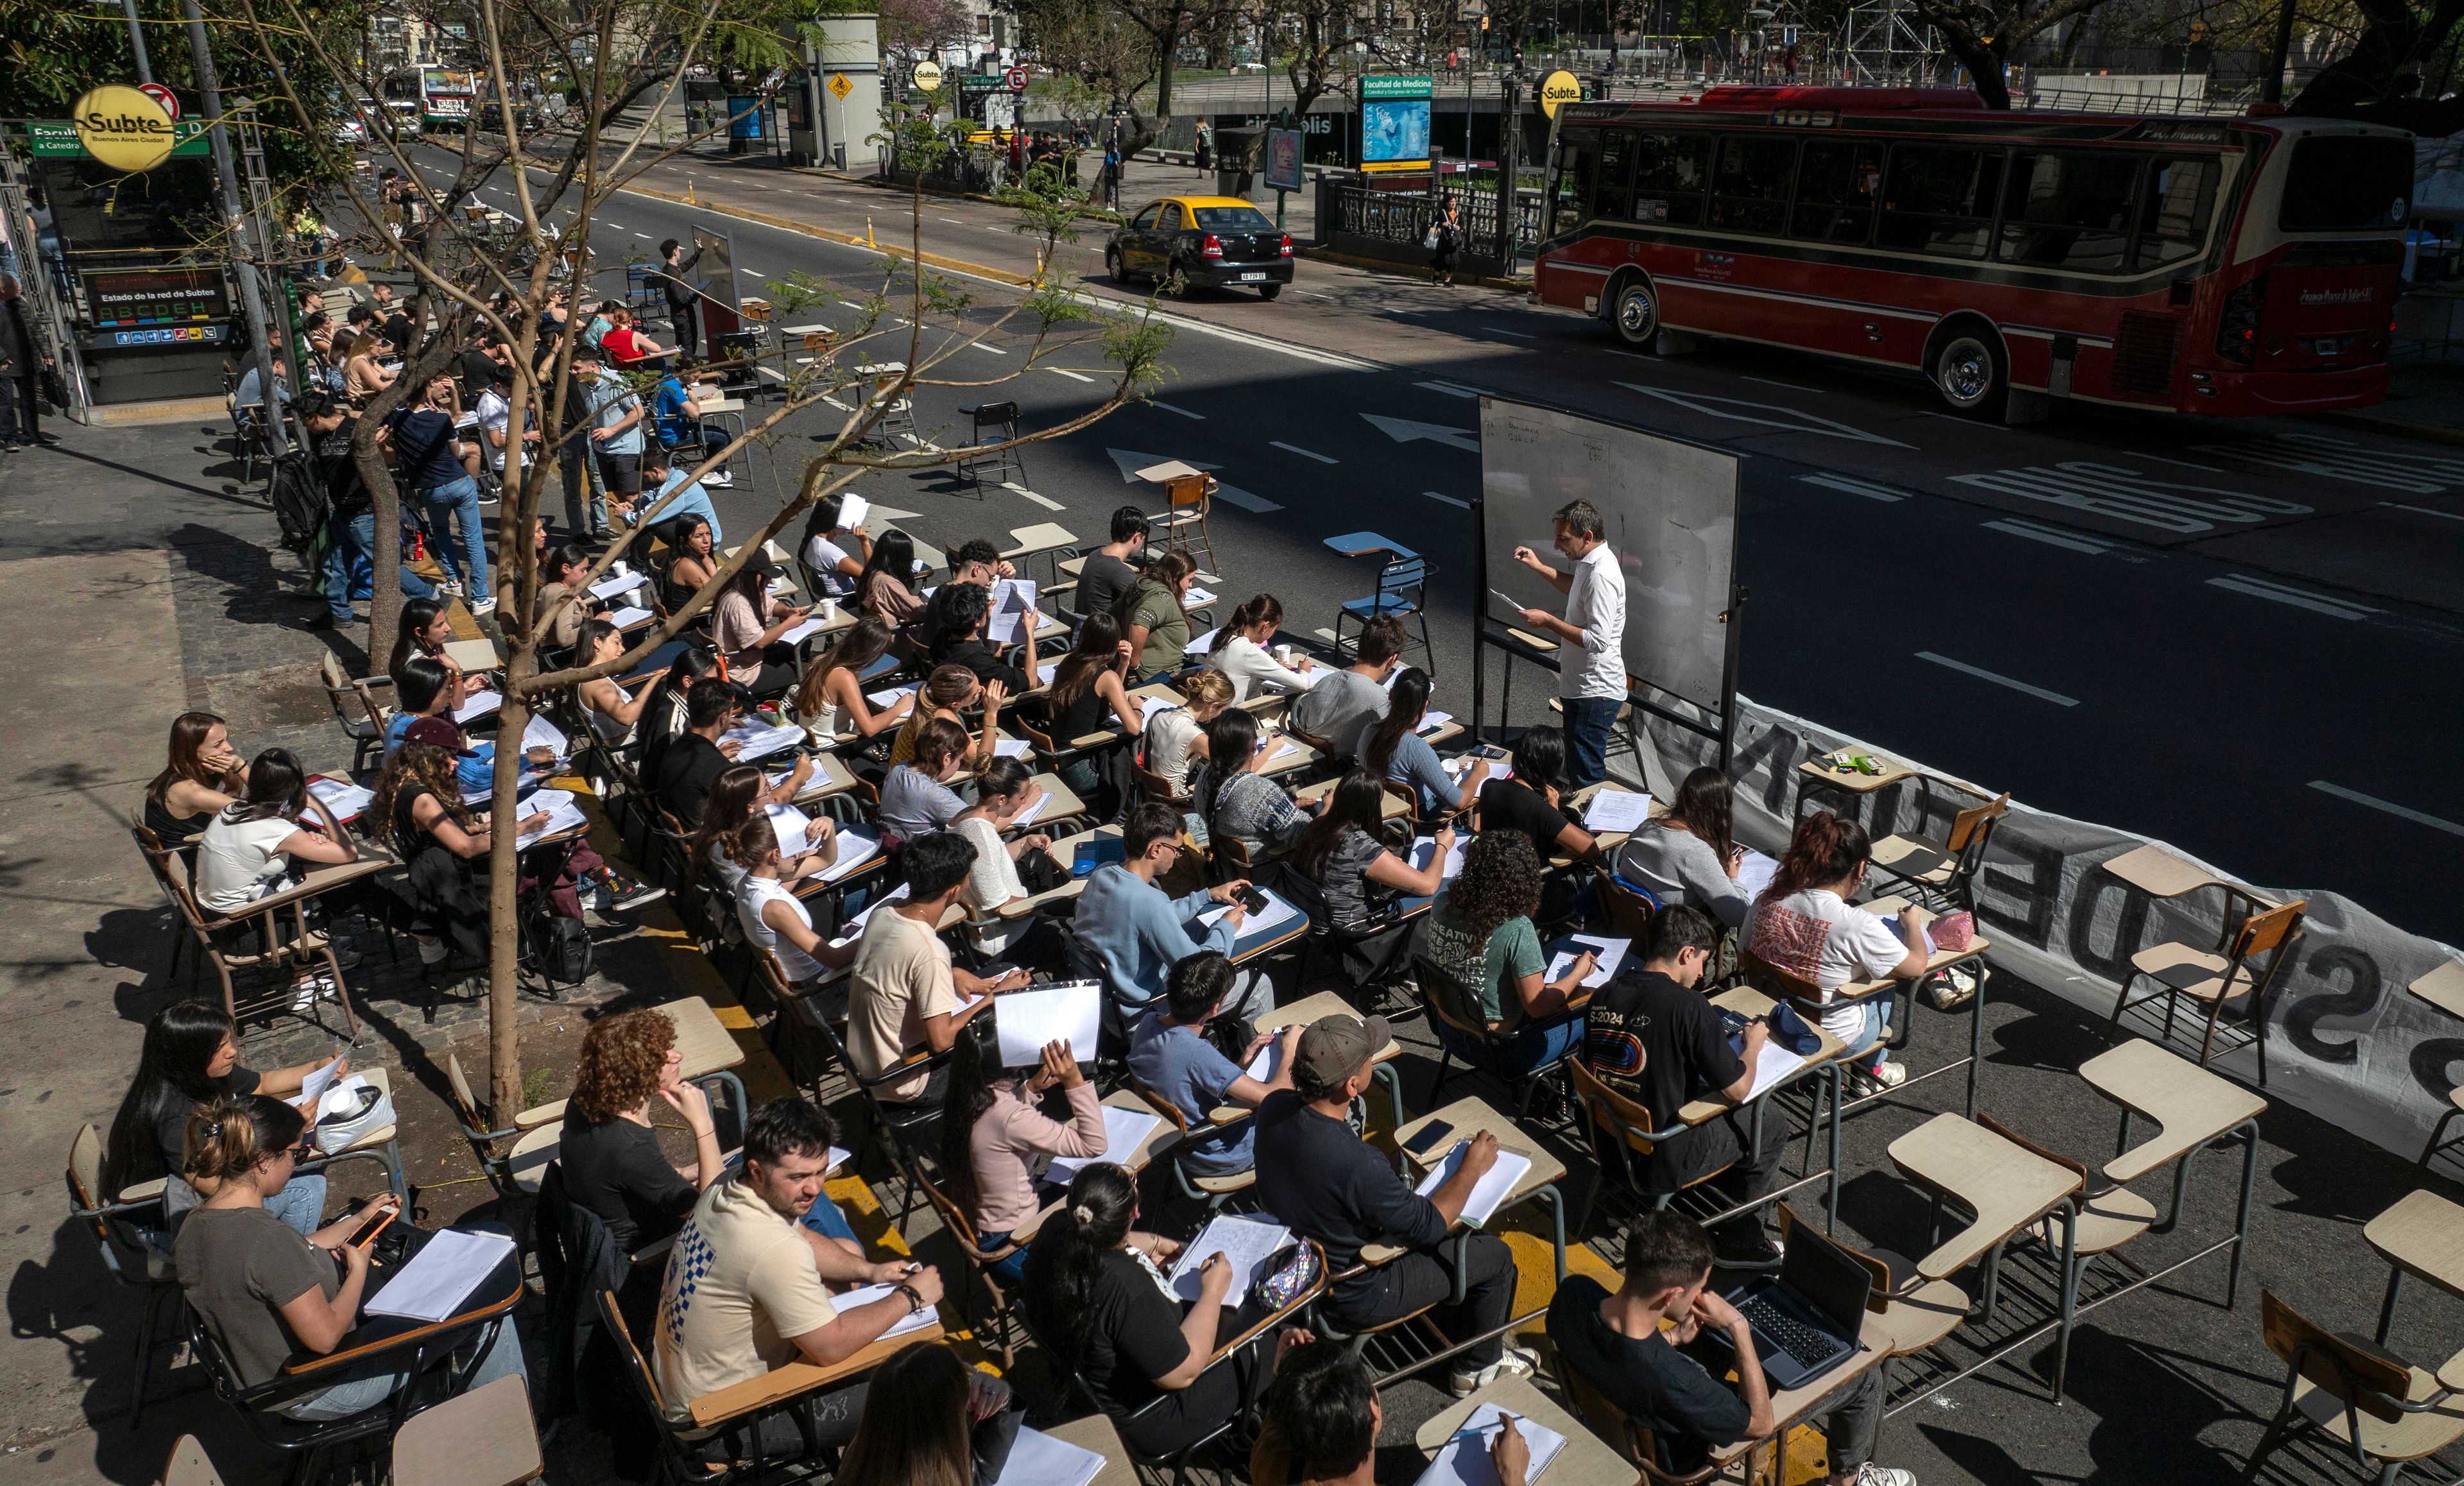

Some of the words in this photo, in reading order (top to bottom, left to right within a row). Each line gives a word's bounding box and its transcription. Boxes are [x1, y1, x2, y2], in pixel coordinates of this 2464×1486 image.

[1403, 80, 1432, 88] Medicina
[1546, 87, 1579, 99] Subte
[1585, 91, 1591, 100] D
[86, 112, 168, 134] Subte
[1774, 109, 1835, 126] 109
[190, 122, 202, 135] D
[1656, 207, 1666, 217] 109
[2394, 202, 2404, 216] 60
[102, 292, 133, 302] Estado
[135, 291, 146, 300] de
[147, 291, 156, 300] la
[157, 290, 172, 299] red
[173, 290, 184, 298] de
[99, 307, 114, 320] A
[117, 307, 133, 318] B
[136, 305, 150, 317] C
[155, 304, 169, 316] D
[173, 302, 188, 314] E
[192, 302, 206, 313] H
[1583, 440, 1603, 450] 4000
[1795, 913, 1833, 930] HAPPY
[1794, 922, 1829, 939] HAPPY
